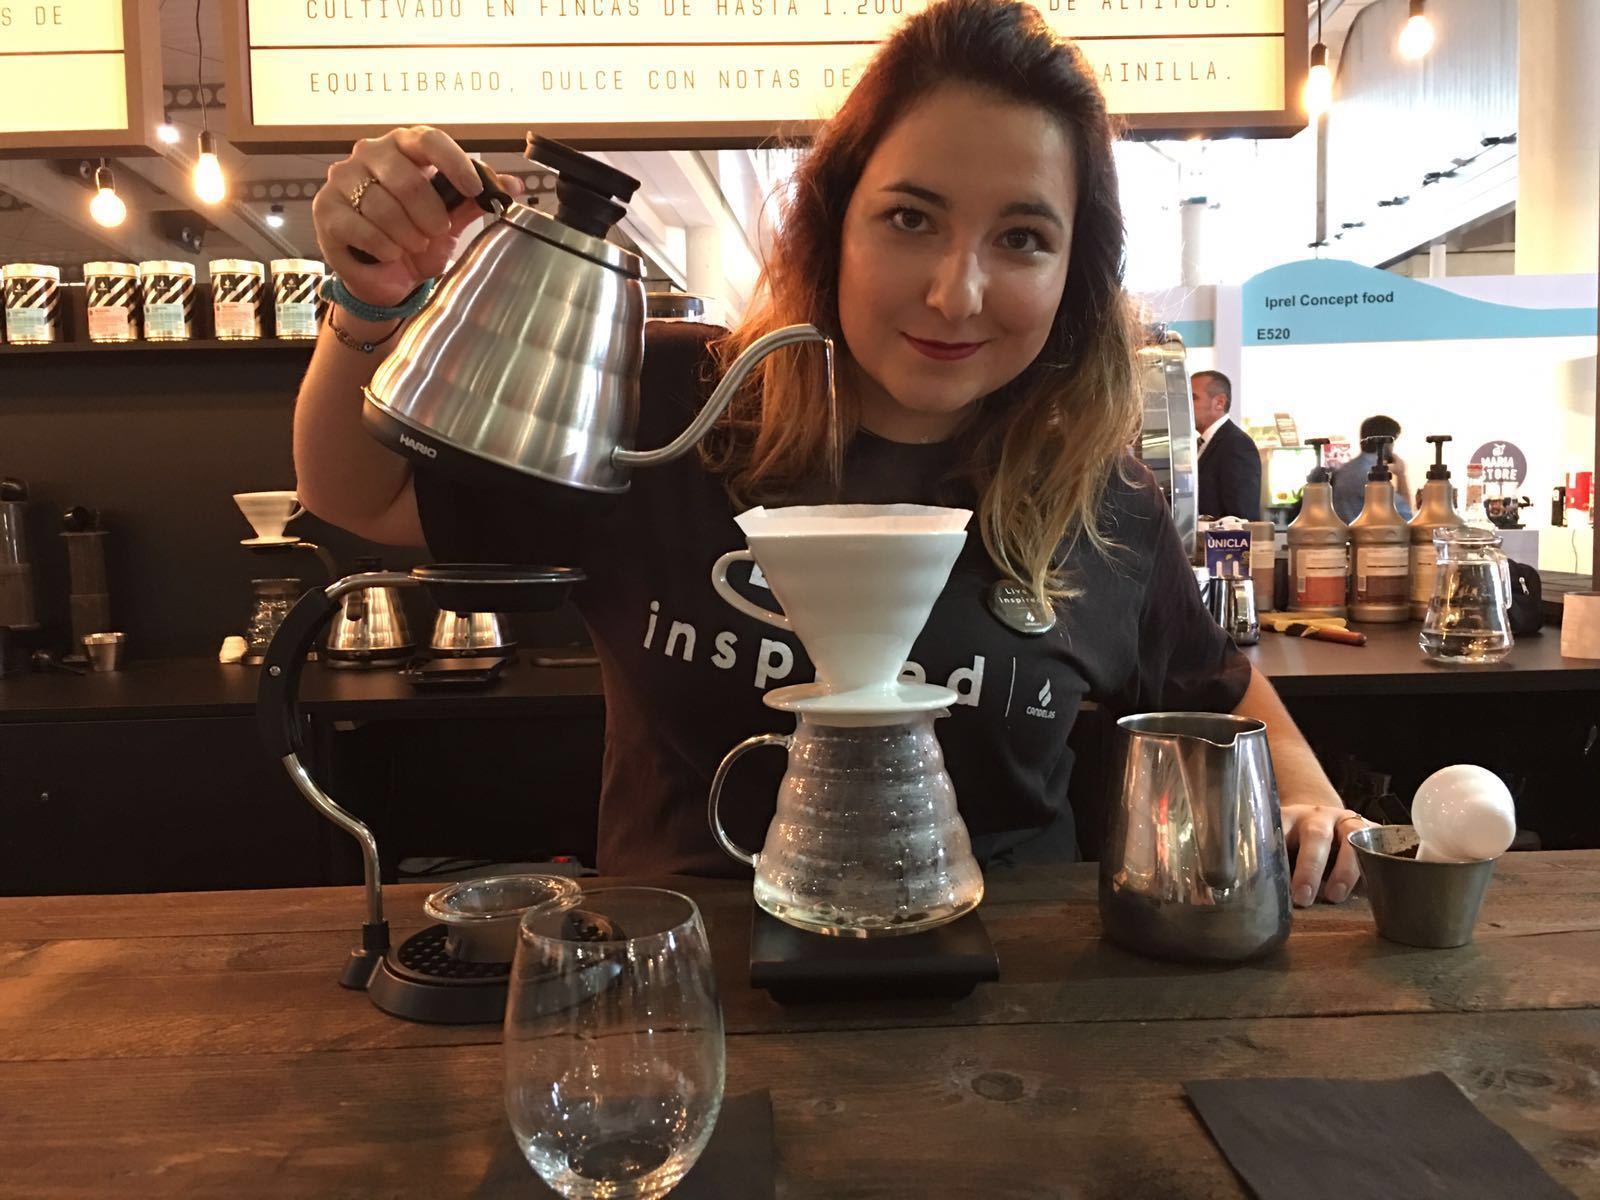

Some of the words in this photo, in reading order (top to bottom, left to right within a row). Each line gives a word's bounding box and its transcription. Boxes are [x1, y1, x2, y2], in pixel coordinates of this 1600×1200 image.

[35, 5, 62, 26] DE
[306, 0, 462, 19] CULTIVADO
[487, 0, 515, 18] EN
[540, 0, 640, 17] FINCAS
[664, 0, 692, 16] DE
[717, 0, 798, 16] HASTA
[310, 71, 513, 95] EQUILIBRADO,
[541, 70, 623, 91] DULCE
[648, 70, 695, 90] CON
[718, 69, 800, 89] NOTAS
[824, 68, 851, 88] DE
[1103, 61, 1232, 82] AINILLA.
[1265, 296, 1296, 310] Iprel
[1300, 293, 1358, 307] Concept
[1362, 291, 1394, 304] food
[1257, 328, 1290, 340] E520
[400, 433, 438, 458] HARIO
[1207, 538, 1249, 549] UNICLA
[643, 600, 986, 707] insped
